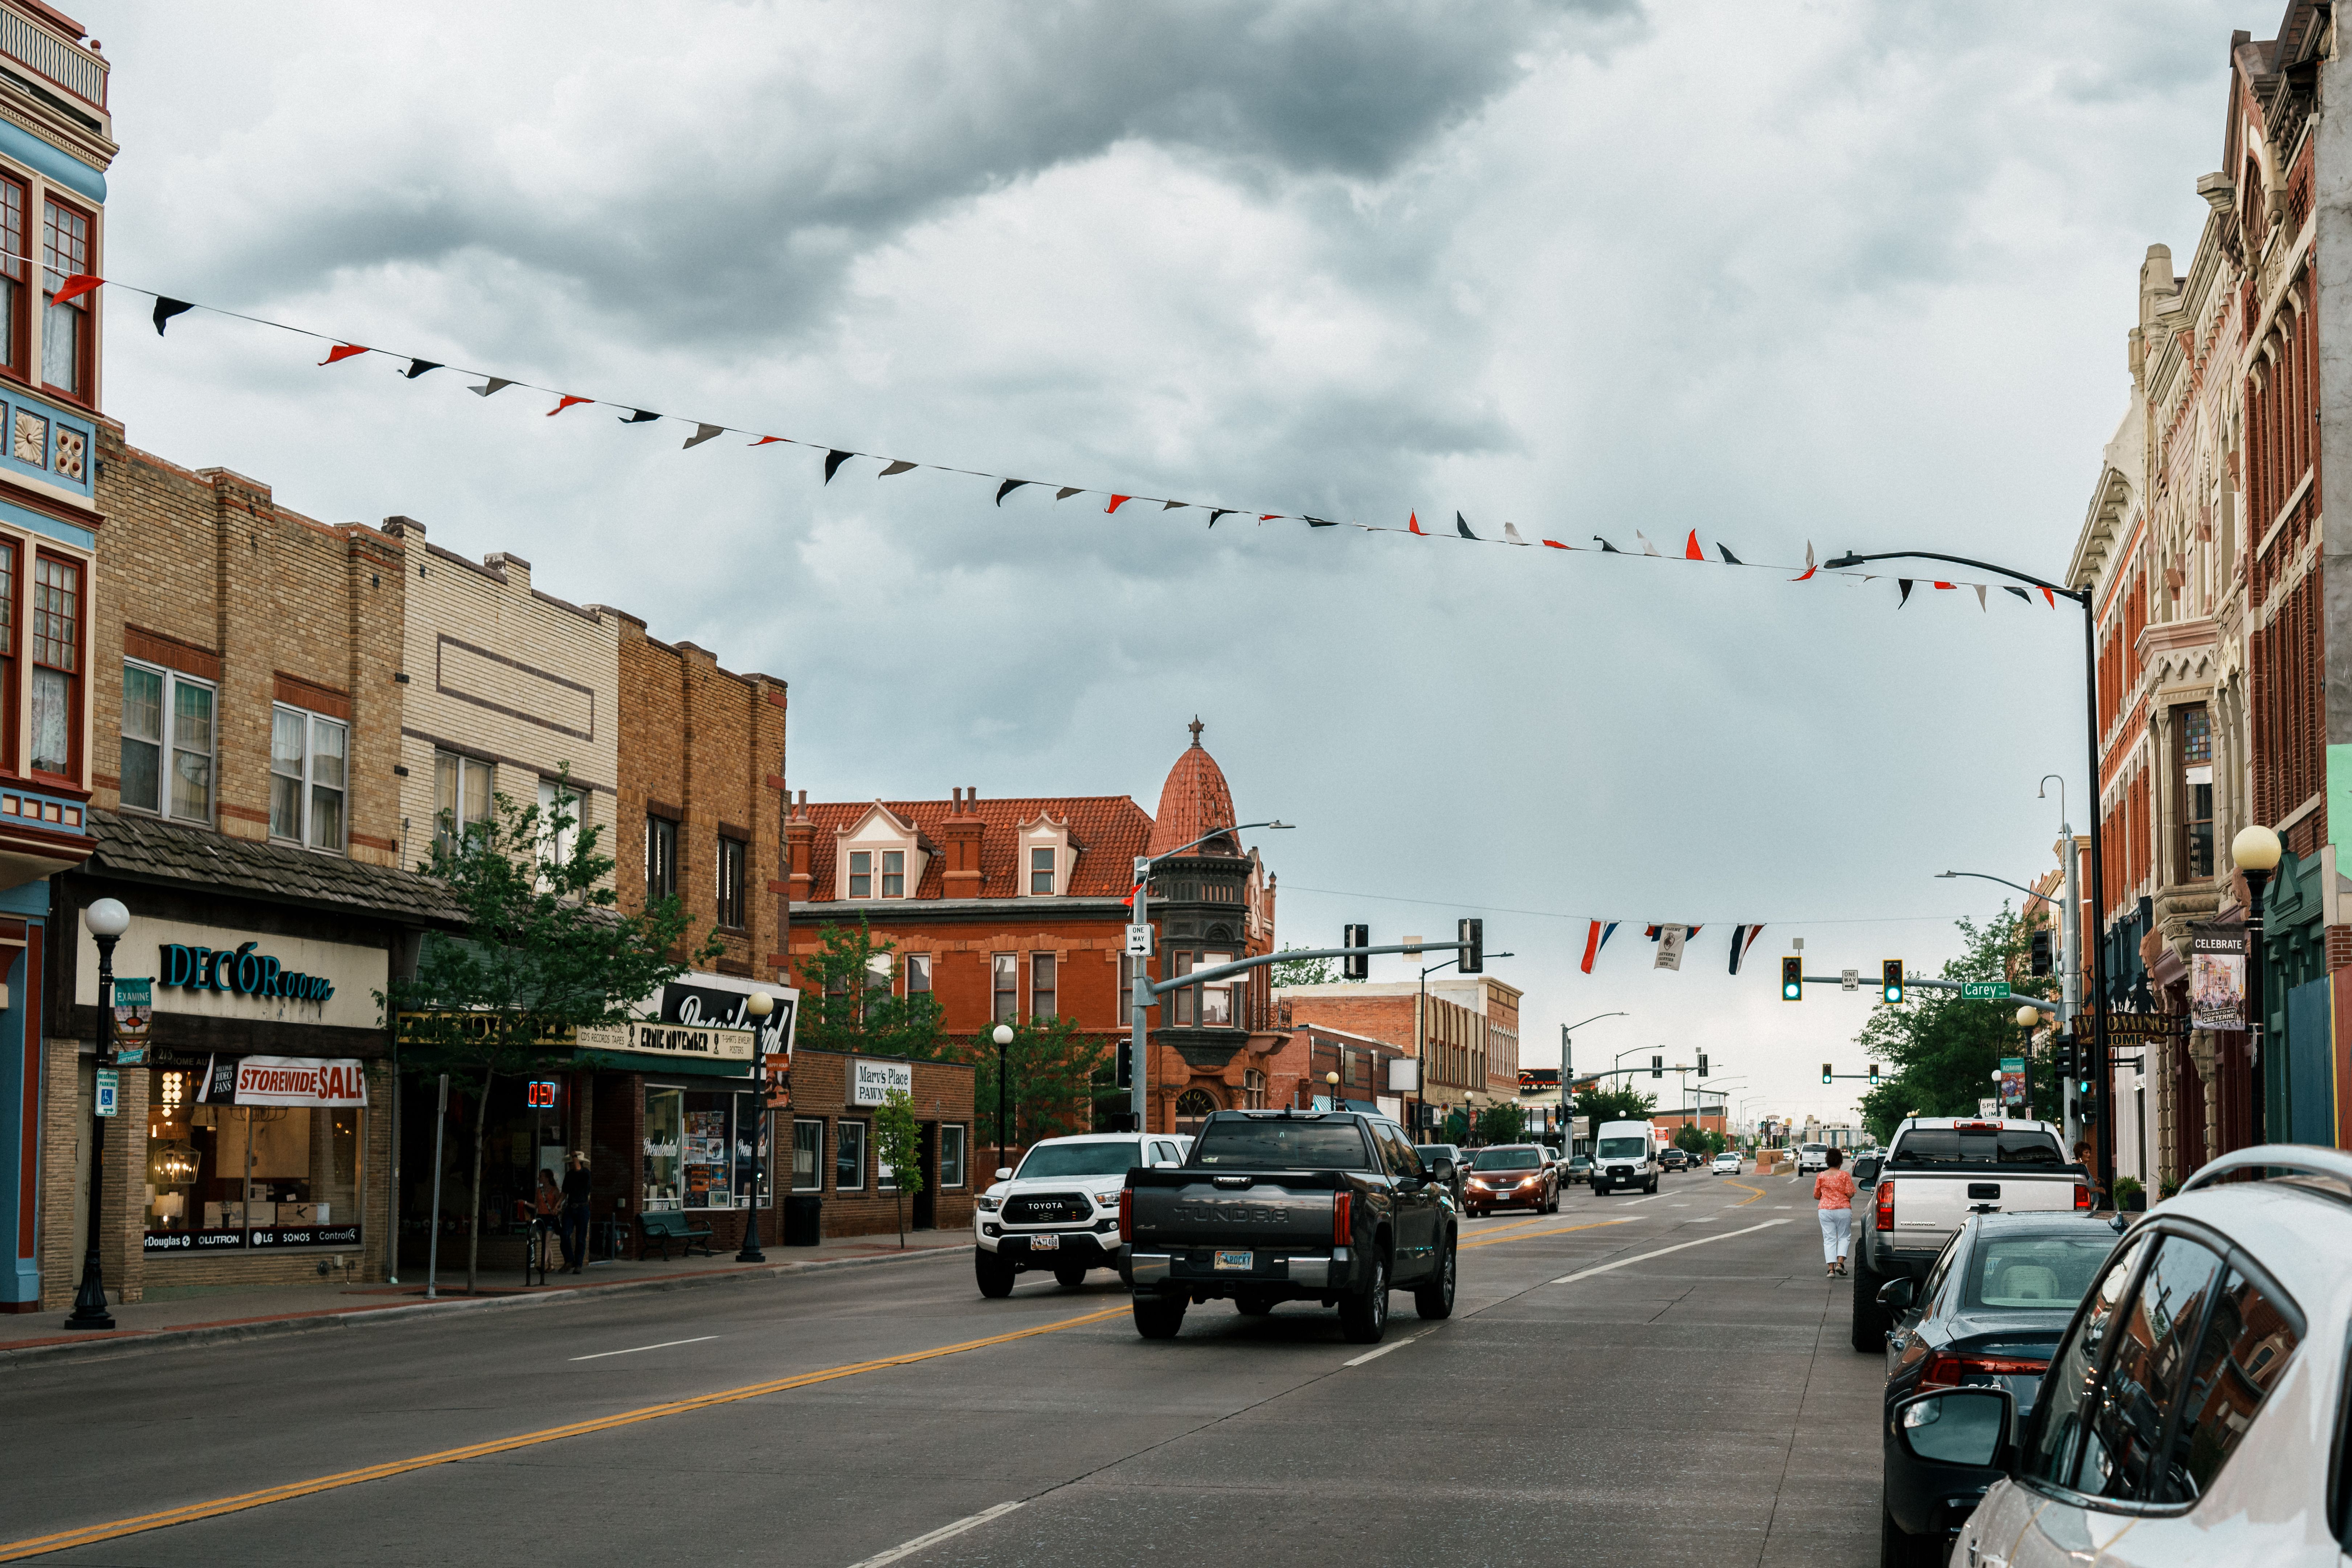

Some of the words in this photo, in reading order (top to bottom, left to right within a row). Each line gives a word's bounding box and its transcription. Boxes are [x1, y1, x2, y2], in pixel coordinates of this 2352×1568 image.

[2195, 939, 2242, 949] CELEBRATE
[1965, 983, 1996, 998] Carey
[117, 992, 150, 1002] EXAMINE
[2203, 1008, 2235, 1017] DOWNTOWN
[2203, 1013, 2235, 1023] CHEYENNE
[2074, 1015, 2169, 1036] WOMING
[581, 1032, 590, 1041] CD'S
[591, 1033, 610, 1044] RECORDS
[612, 1036, 624, 1045] TAPES
[641, 1027, 665, 1049] ERNIE
[666, 1030, 708, 1052] NOVEMBER
[722, 1035, 737, 1044] T-SHIRTS
[737, 1036, 751, 1045] JEWELRY
[729, 1046, 744, 1054] POSTERS
[216, 1071, 232, 1081] RODEO
[859, 1066, 886, 1084] Marv's
[889, 1069, 908, 1085] Place
[214, 1081, 232, 1093] FANS
[239, 1069, 318, 1093] STOREWIDE
[318, 1066, 363, 1099] SALE
[859, 1086, 883, 1100] PAWN
[1173, 1208, 1289, 1223] TUNDRA
[263, 1234, 273, 1242] LG
[283, 1233, 310, 1242] SONOS
[1229, 1255, 1251, 1265] ROCKY
